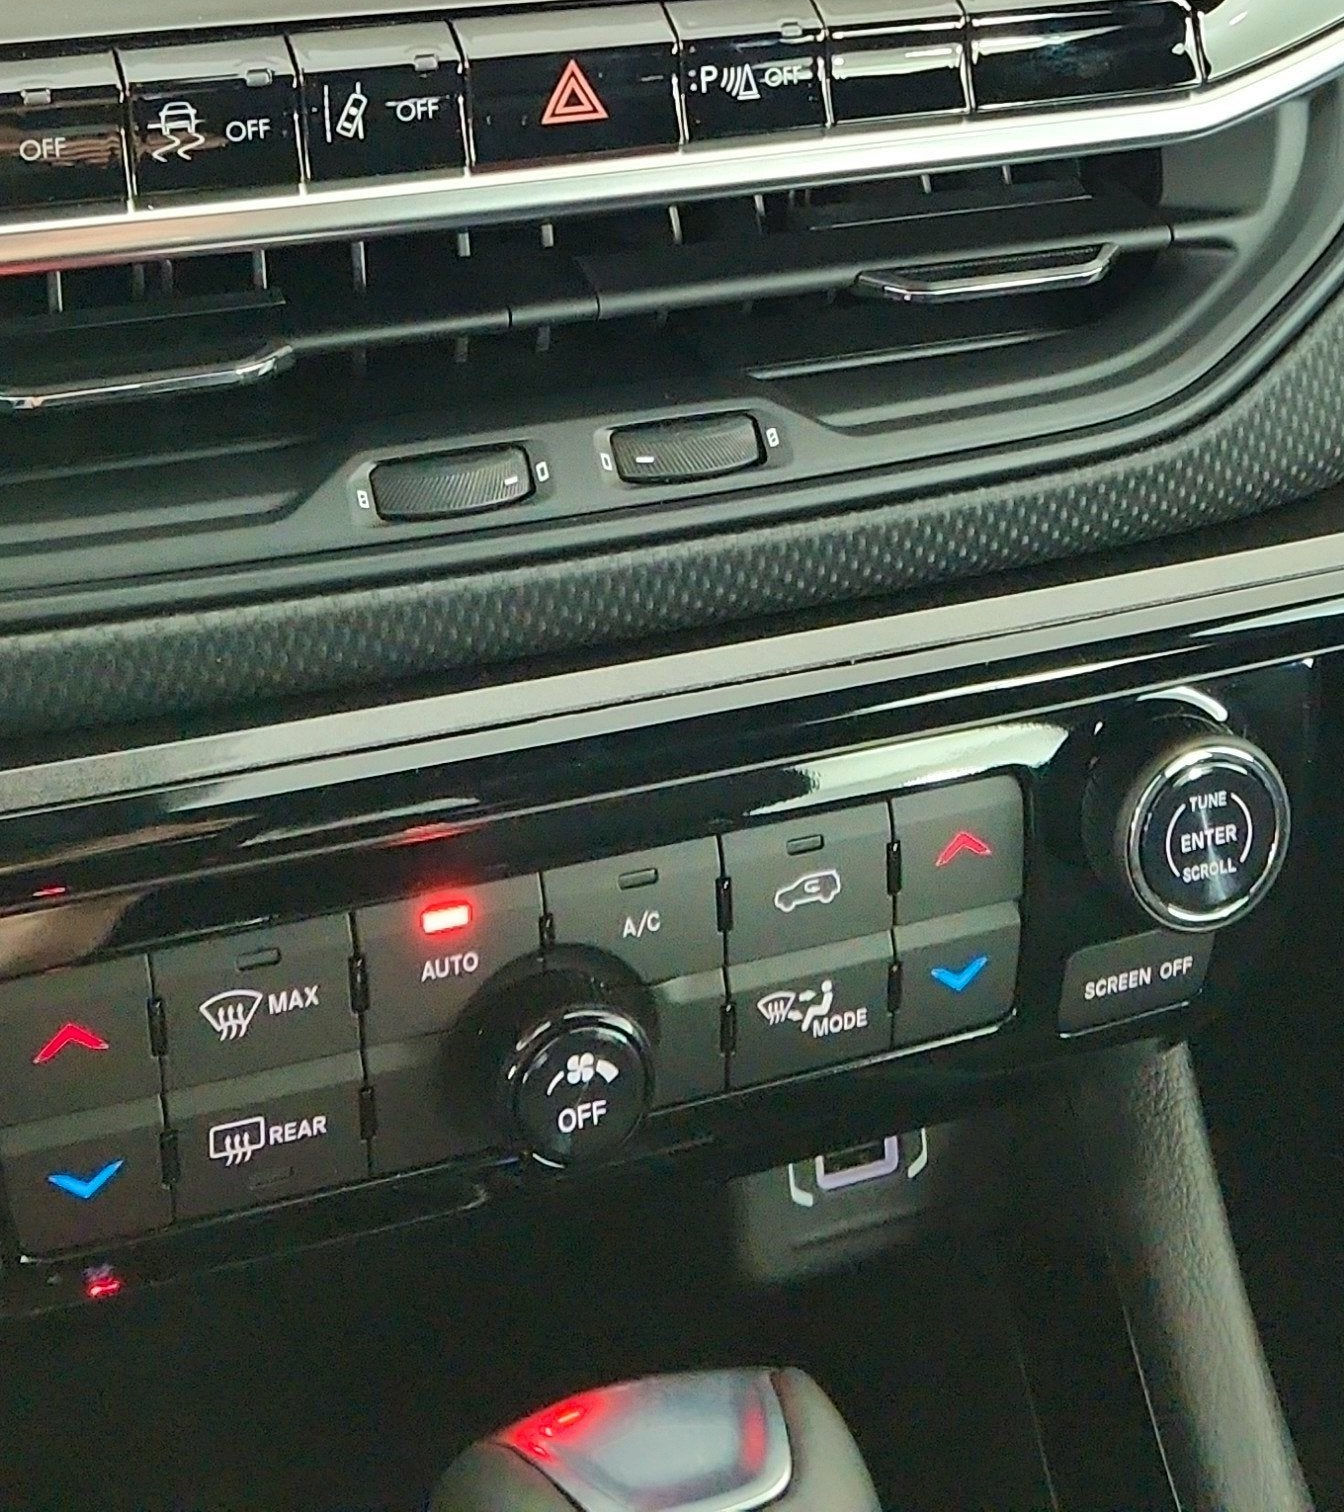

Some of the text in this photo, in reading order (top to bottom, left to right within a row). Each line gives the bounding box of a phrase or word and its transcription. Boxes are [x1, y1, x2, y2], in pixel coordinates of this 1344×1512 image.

[700, 65, 718, 93] P
[764, 65, 803, 87] OFF
[396, 99, 439, 123] OFF
[224, 118, 271, 144] OFF
[18, 136, 67, 161] OFF
[1189, 791, 1227, 811] TUNE
[1180, 824, 1238, 852] ENTER
[1182, 859, 1237, 882] SCROLL
[622, 912, 662, 938] A/C
[420, 953, 480, 979] AUTO
[1084, 956, 1194, 999] SCREEN OFF
[267, 986, 320, 1016] MAX
[812, 1009, 868, 1038] MODE
[268, 1116, 328, 1144] REAR
[557, 1100, 607, 1134] OFF
